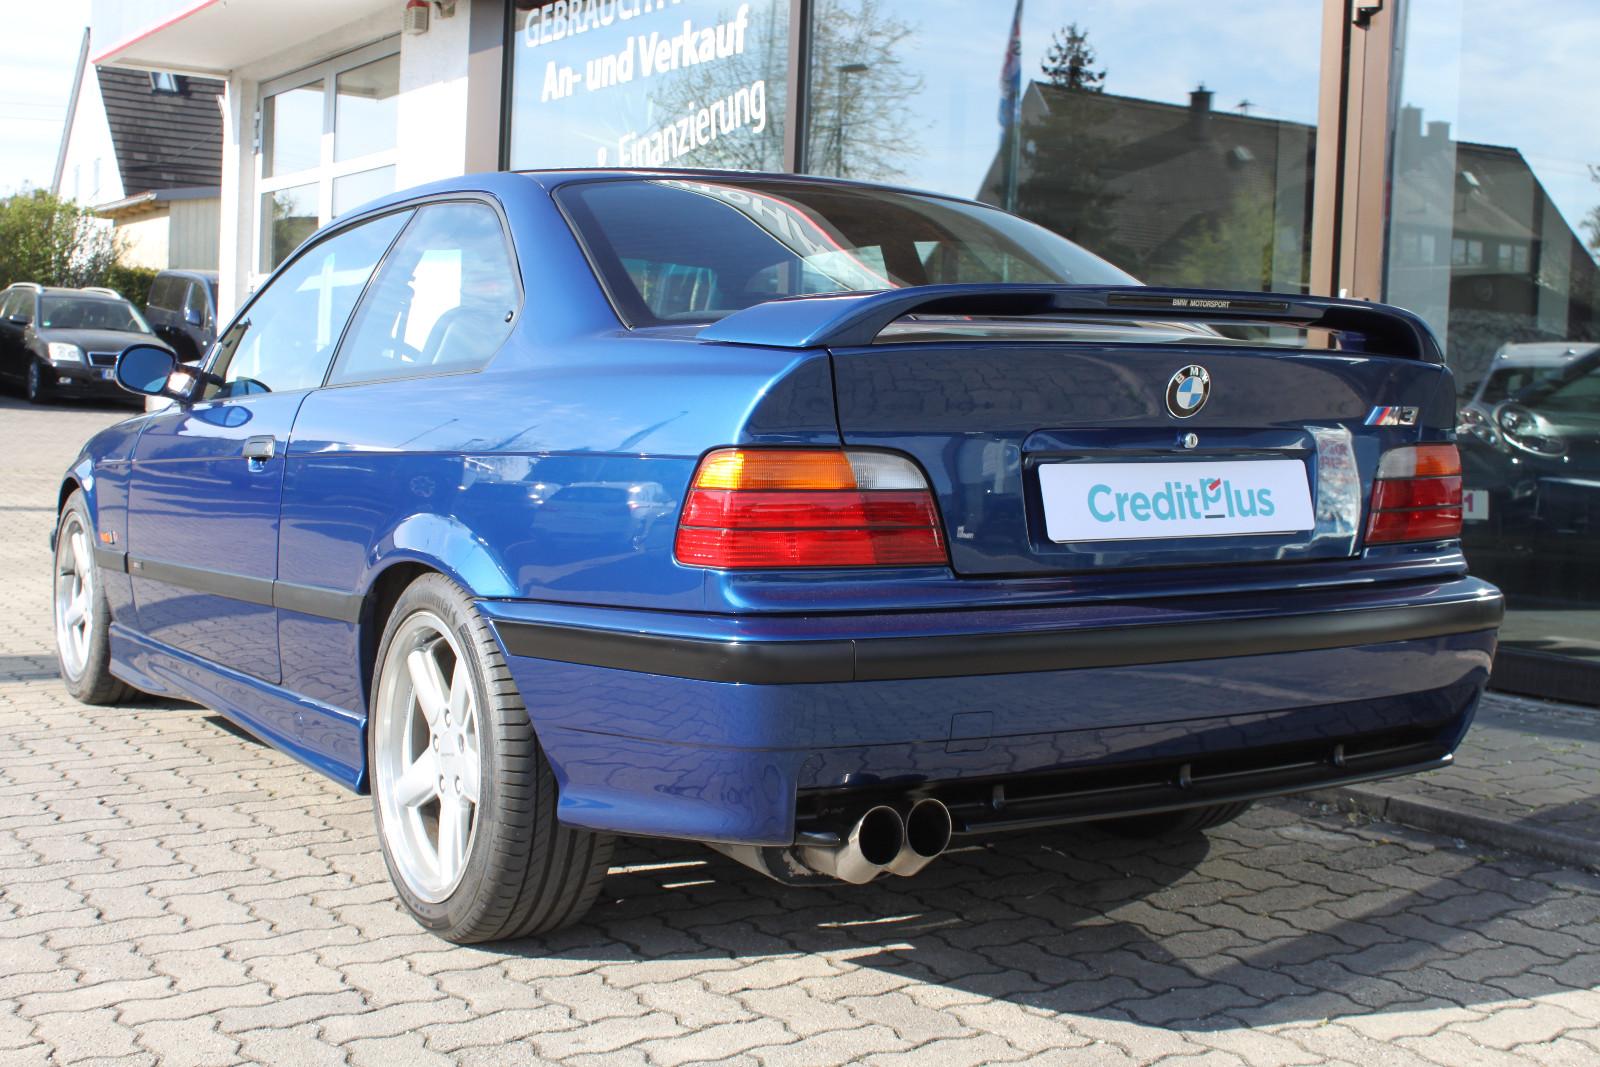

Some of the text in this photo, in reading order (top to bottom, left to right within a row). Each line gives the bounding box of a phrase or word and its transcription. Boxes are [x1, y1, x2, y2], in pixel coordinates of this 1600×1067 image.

[523, 0, 681, 48] GEBRAUC
[541, 3, 750, 102] An- und Verkauf
[618, 79, 767, 166] Finanzierung
[1172, 298, 1232, 309] BMW MOTORSPORT
[1174, 366, 1210, 385] BMW
